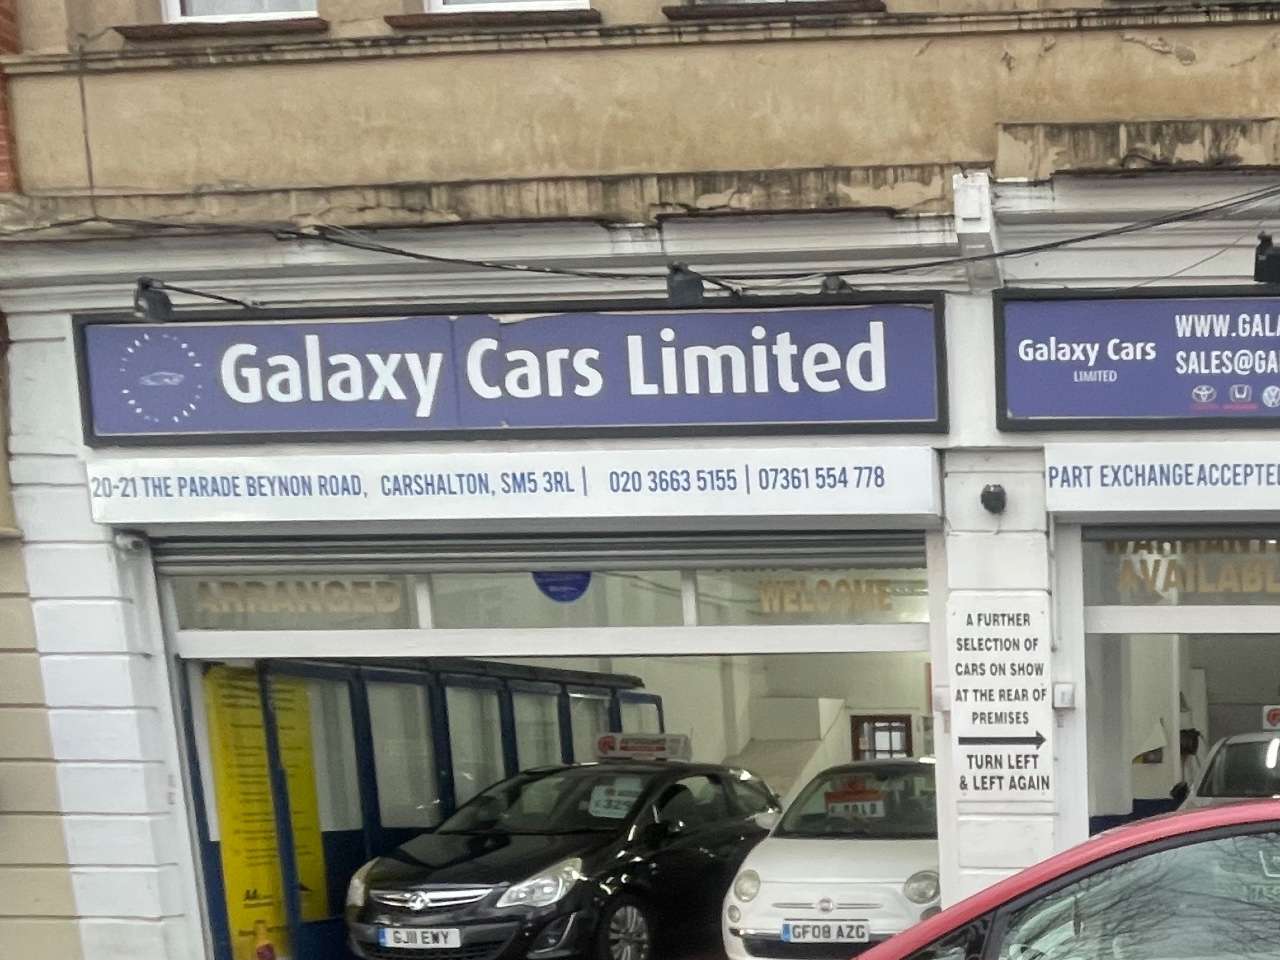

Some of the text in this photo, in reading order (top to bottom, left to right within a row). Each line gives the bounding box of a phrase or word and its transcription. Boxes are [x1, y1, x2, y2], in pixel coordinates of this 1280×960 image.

[1018, 336, 1156, 367] Galaxy Cars
[220, 320, 887, 418] Galaxy Cars Limited
[1073, 369, 1117, 383] LIMITED
[92, 465, 885, 499] 20-21 THE PARADE BEYNON ROAD, CARSHALTON, SM5 3RL 020 3663 5155 07361 554 778
[1048, 465, 1093, 488] PART
[1100, 463, 1194, 487] EXCHANGE
[758, 578, 892, 613] WELCOME
[966, 613, 1031, 627] A FURTHER
[956, 637, 1039, 652] SELECTION OF
[955, 662, 1044, 676] CARS ON SHOW
[955, 688, 1047, 702] AT THE REAR OF
[971, 711, 1029, 725] PREMISES
[966, 754, 1039, 769] TURN LEFT
[959, 775, 1050, 790] & LEFT AGAIN
[792, 924, 832, 939] GF08
